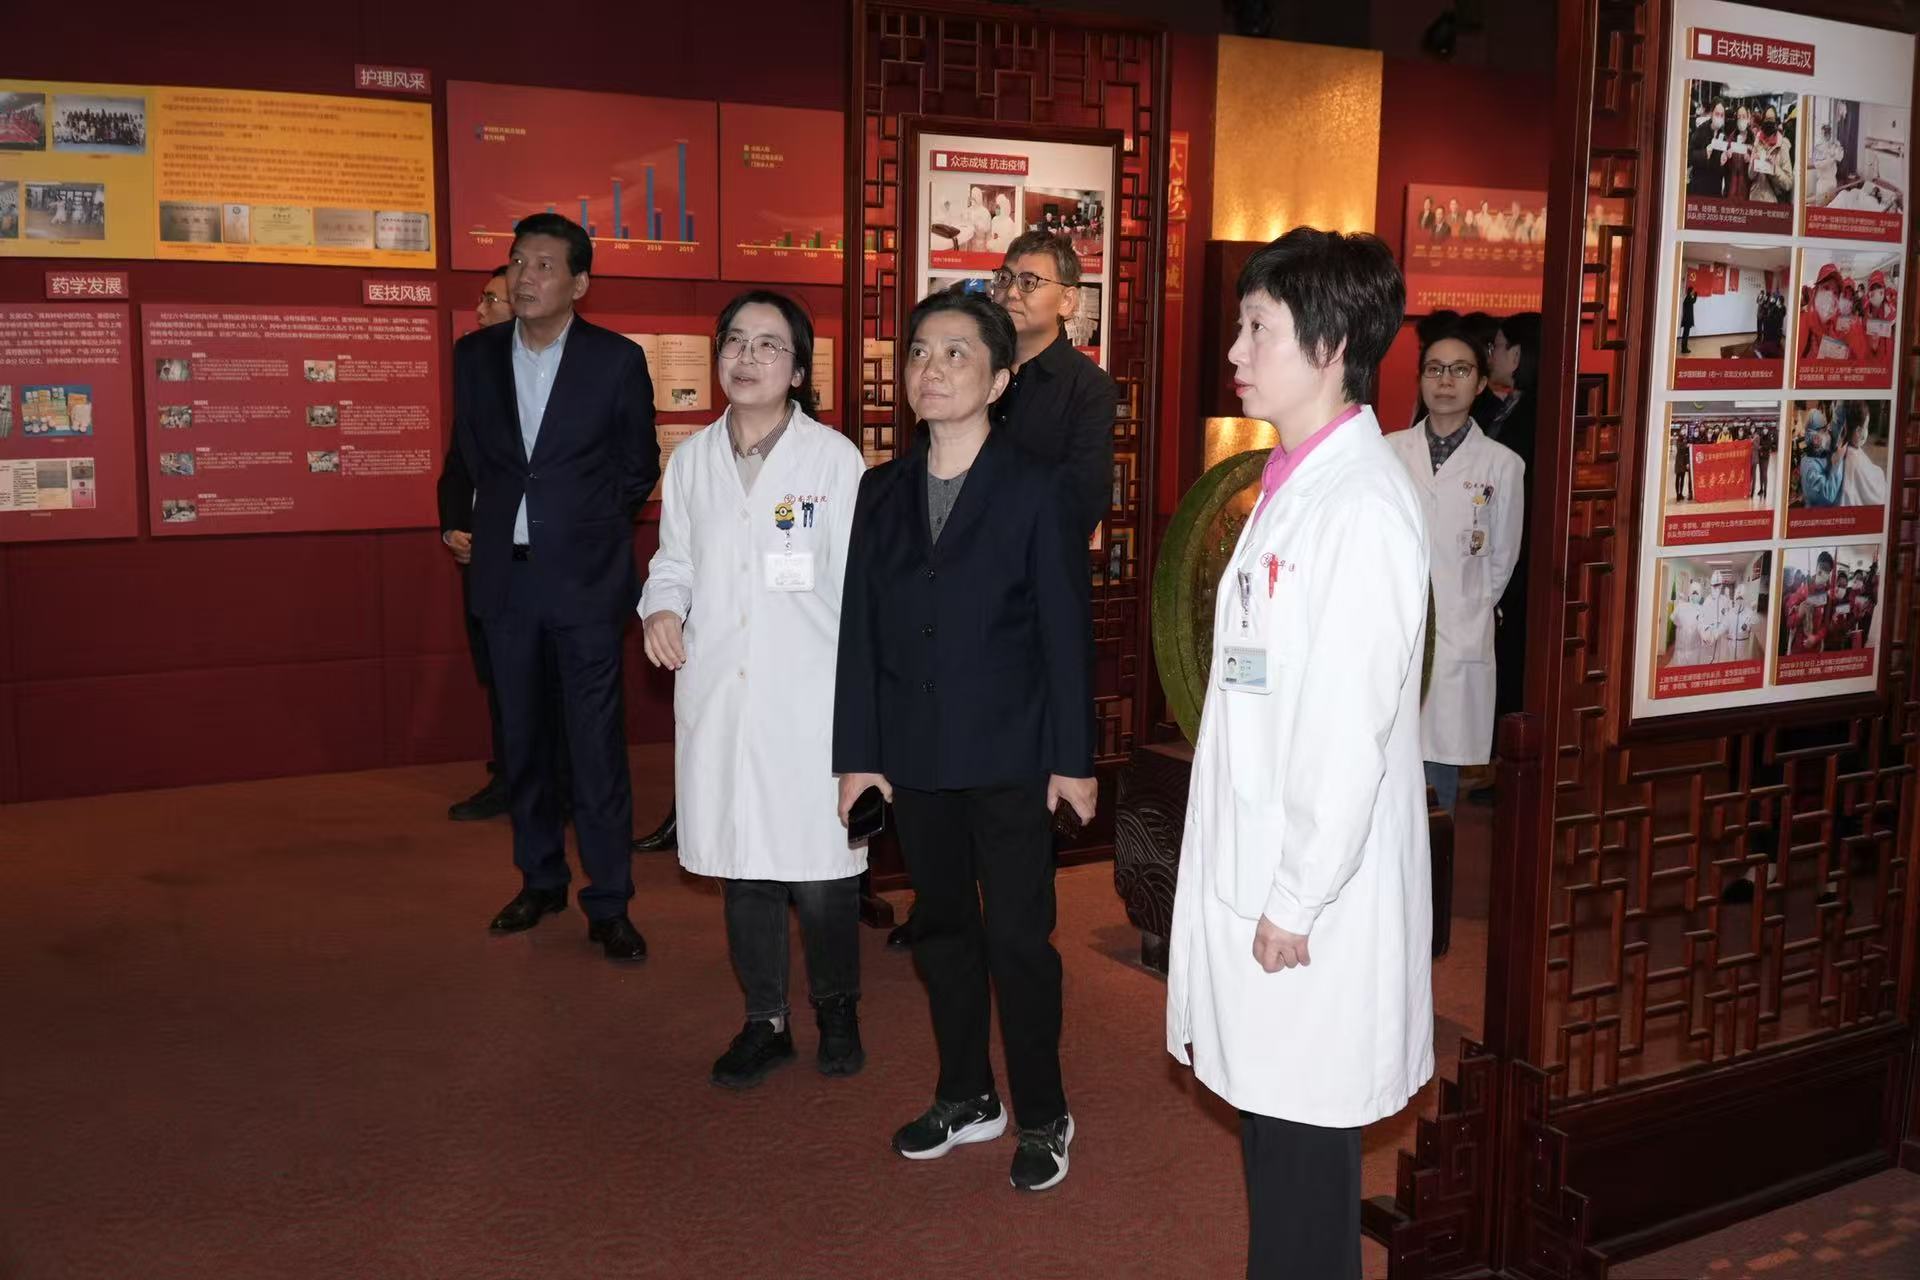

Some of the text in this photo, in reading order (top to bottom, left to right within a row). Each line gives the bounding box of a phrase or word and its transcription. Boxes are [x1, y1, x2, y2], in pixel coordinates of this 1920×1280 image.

[1717, 37, 1812, 69] 白衣执甲 驰援武汉
[360, 68, 426, 90] 护理风采
[949, 155, 1026, 172] 众志成城 抗击疫情
[613, 242, 630, 250] 2000
[51, 275, 122, 296] 药学发展
[368, 283, 432, 303] 医技风貌
